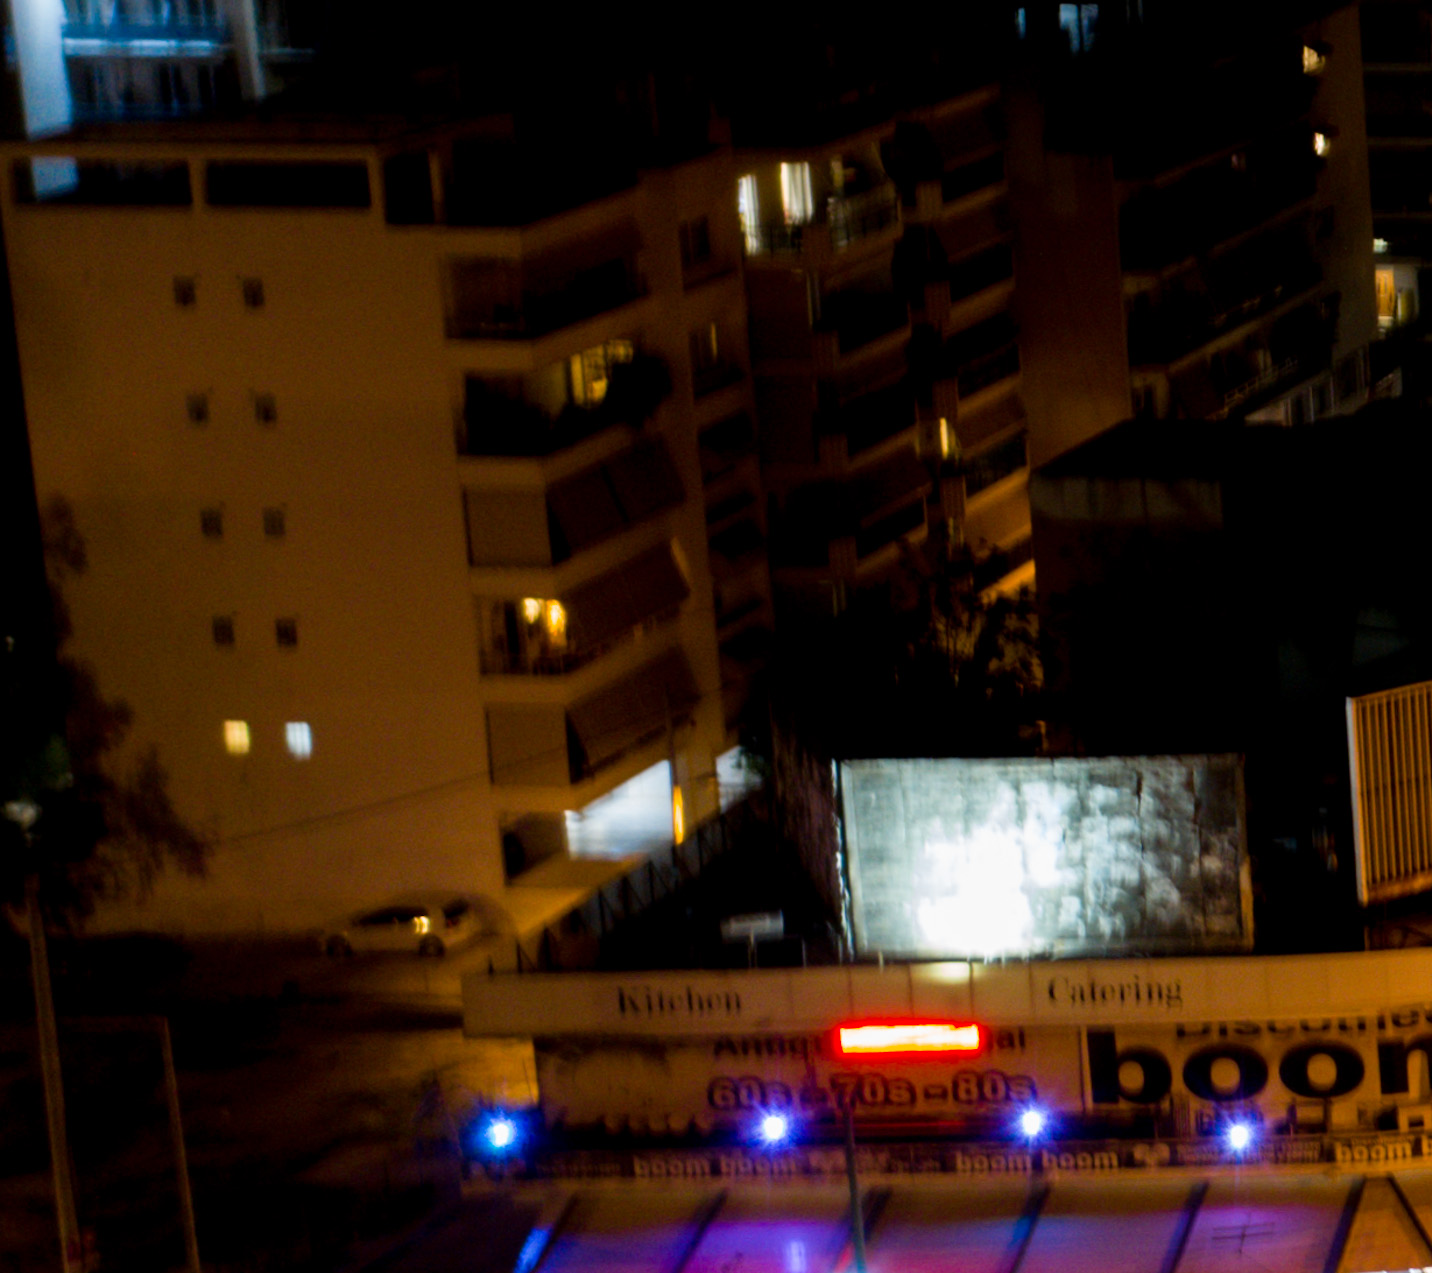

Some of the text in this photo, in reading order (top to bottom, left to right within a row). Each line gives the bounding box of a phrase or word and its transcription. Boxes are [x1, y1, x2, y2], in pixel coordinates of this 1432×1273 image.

[616, 983, 743, 1017] Kitchen
[1047, 973, 1184, 1010] Catering
[830, 1071, 917, 1108] 70s
[951, 1069, 1038, 1105] 80s
[1335, 1140, 1412, 1162] boom
